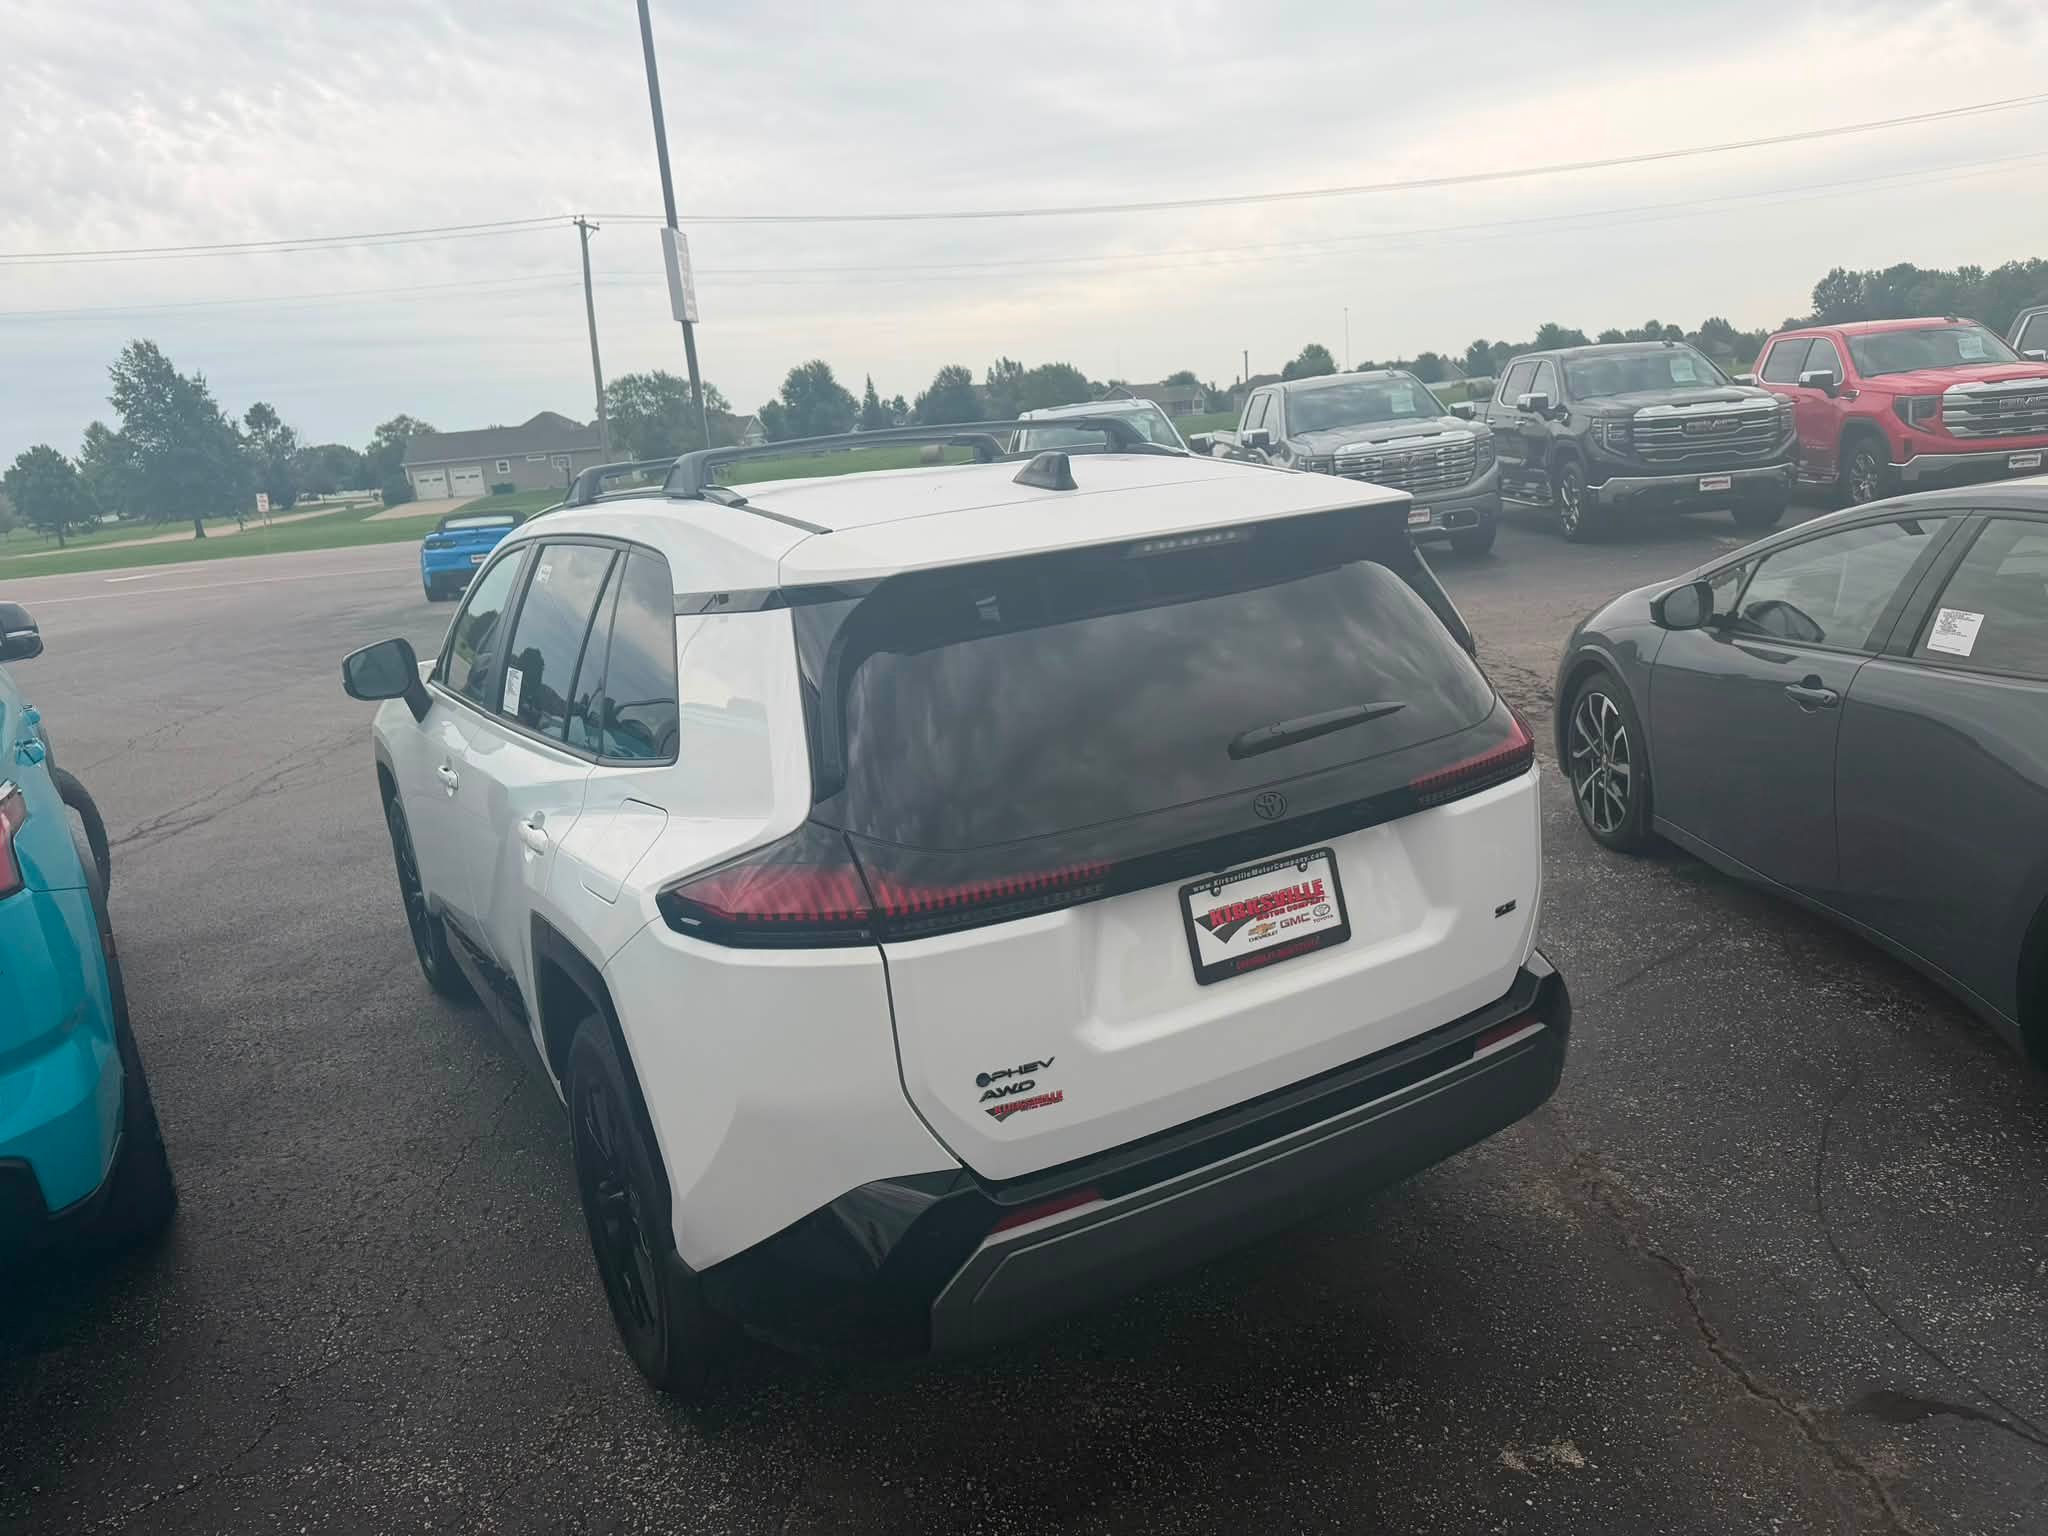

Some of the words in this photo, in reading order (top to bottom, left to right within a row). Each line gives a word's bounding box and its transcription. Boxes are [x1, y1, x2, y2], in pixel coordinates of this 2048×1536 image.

[1208, 879, 1325, 927] KIRKSVILLE
[1280, 914, 1311, 928] GMC
[1313, 914, 1334, 923] TOYOTA
[1248, 931, 1278, 942] CHEVROLET
[990, 1056, 1055, 1082] PHEV
[979, 1079, 1036, 1103] AWD
